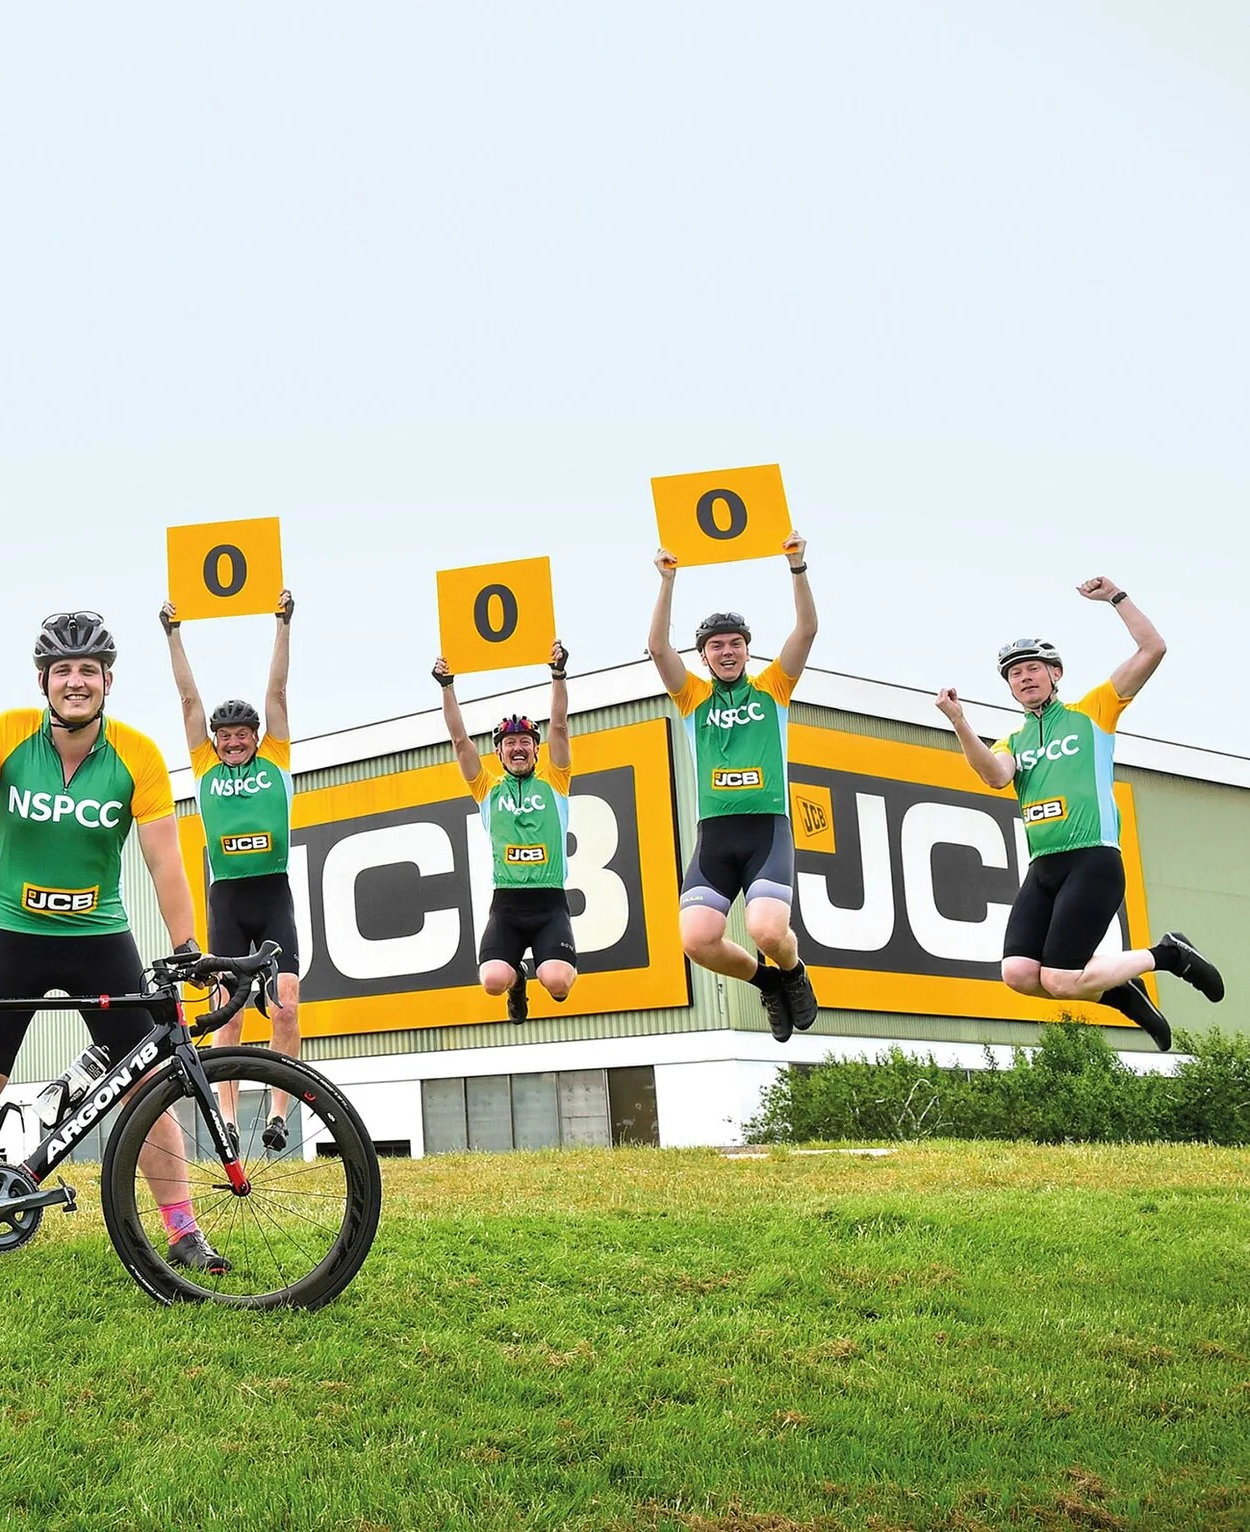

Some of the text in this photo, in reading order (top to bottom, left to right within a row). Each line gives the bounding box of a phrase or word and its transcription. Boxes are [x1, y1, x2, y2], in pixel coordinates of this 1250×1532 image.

[696, 489, 748, 540] 0
[202, 543, 248, 597] 0
[473, 583, 518, 643] 0
[706, 702, 766, 729] NSPCC
[208, 770, 273, 797] NSPCC
[714, 771, 760, 787] JCB
[8, 785, 124, 829] NSPCC
[802, 801, 827, 832] JCB
[225, 836, 268, 851] JCB
[508, 848, 544, 861] JCB
[27, 892, 94, 911] JCB
[47, 1041, 159, 1165] ARGON 18
